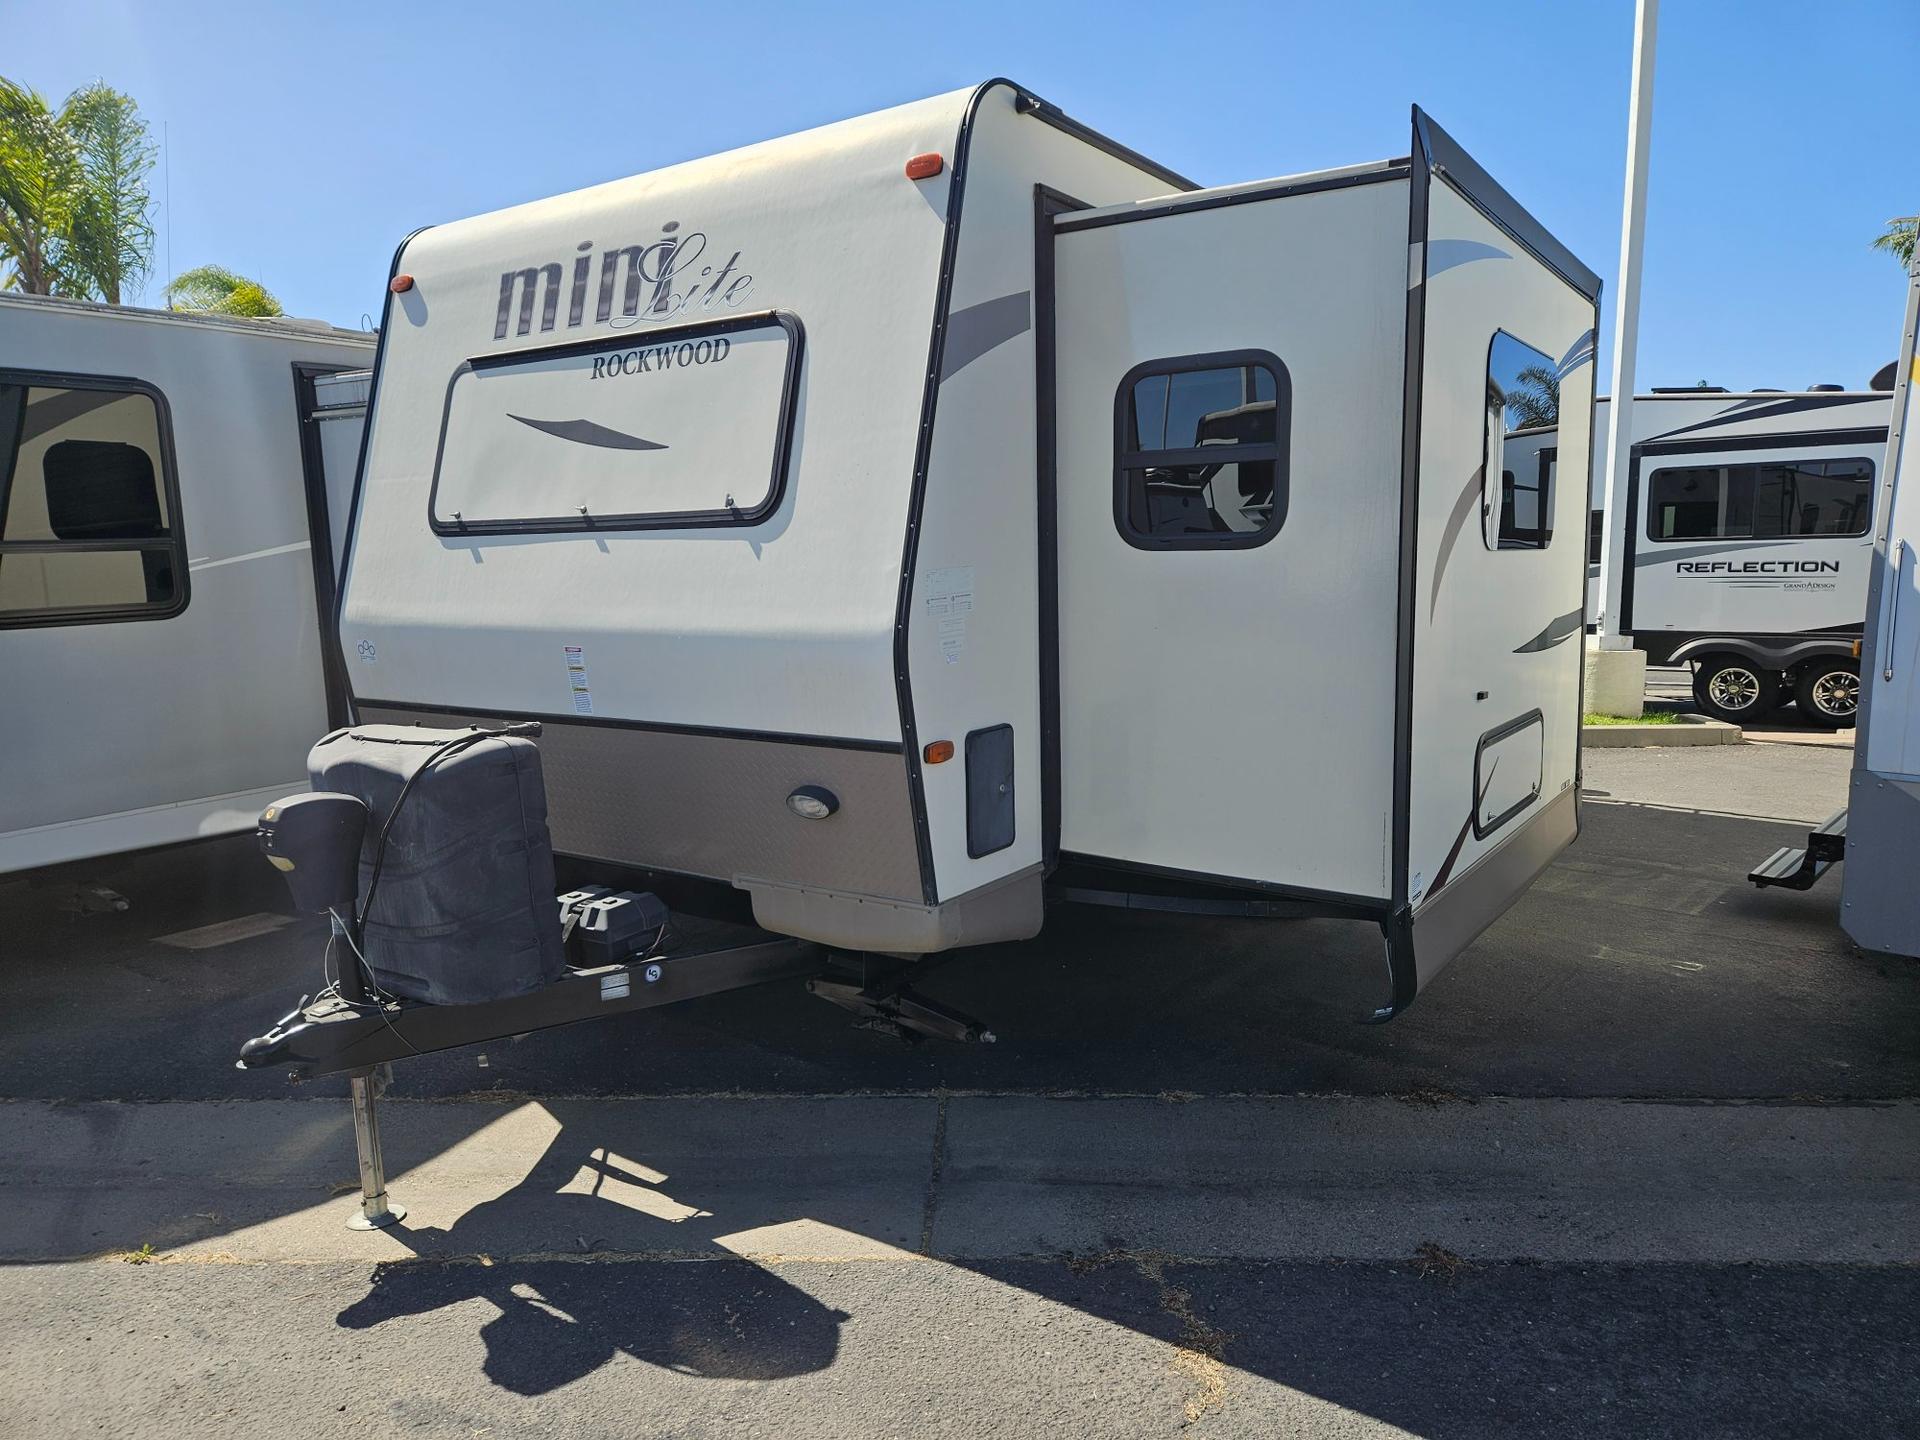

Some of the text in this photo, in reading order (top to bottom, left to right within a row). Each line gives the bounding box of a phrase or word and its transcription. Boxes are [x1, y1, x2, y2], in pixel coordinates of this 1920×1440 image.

[494, 220, 755, 340] mini Lite
[590, 338, 731, 380] ROCKWOOD
[1676, 560, 1840, 574] REFLECTION
